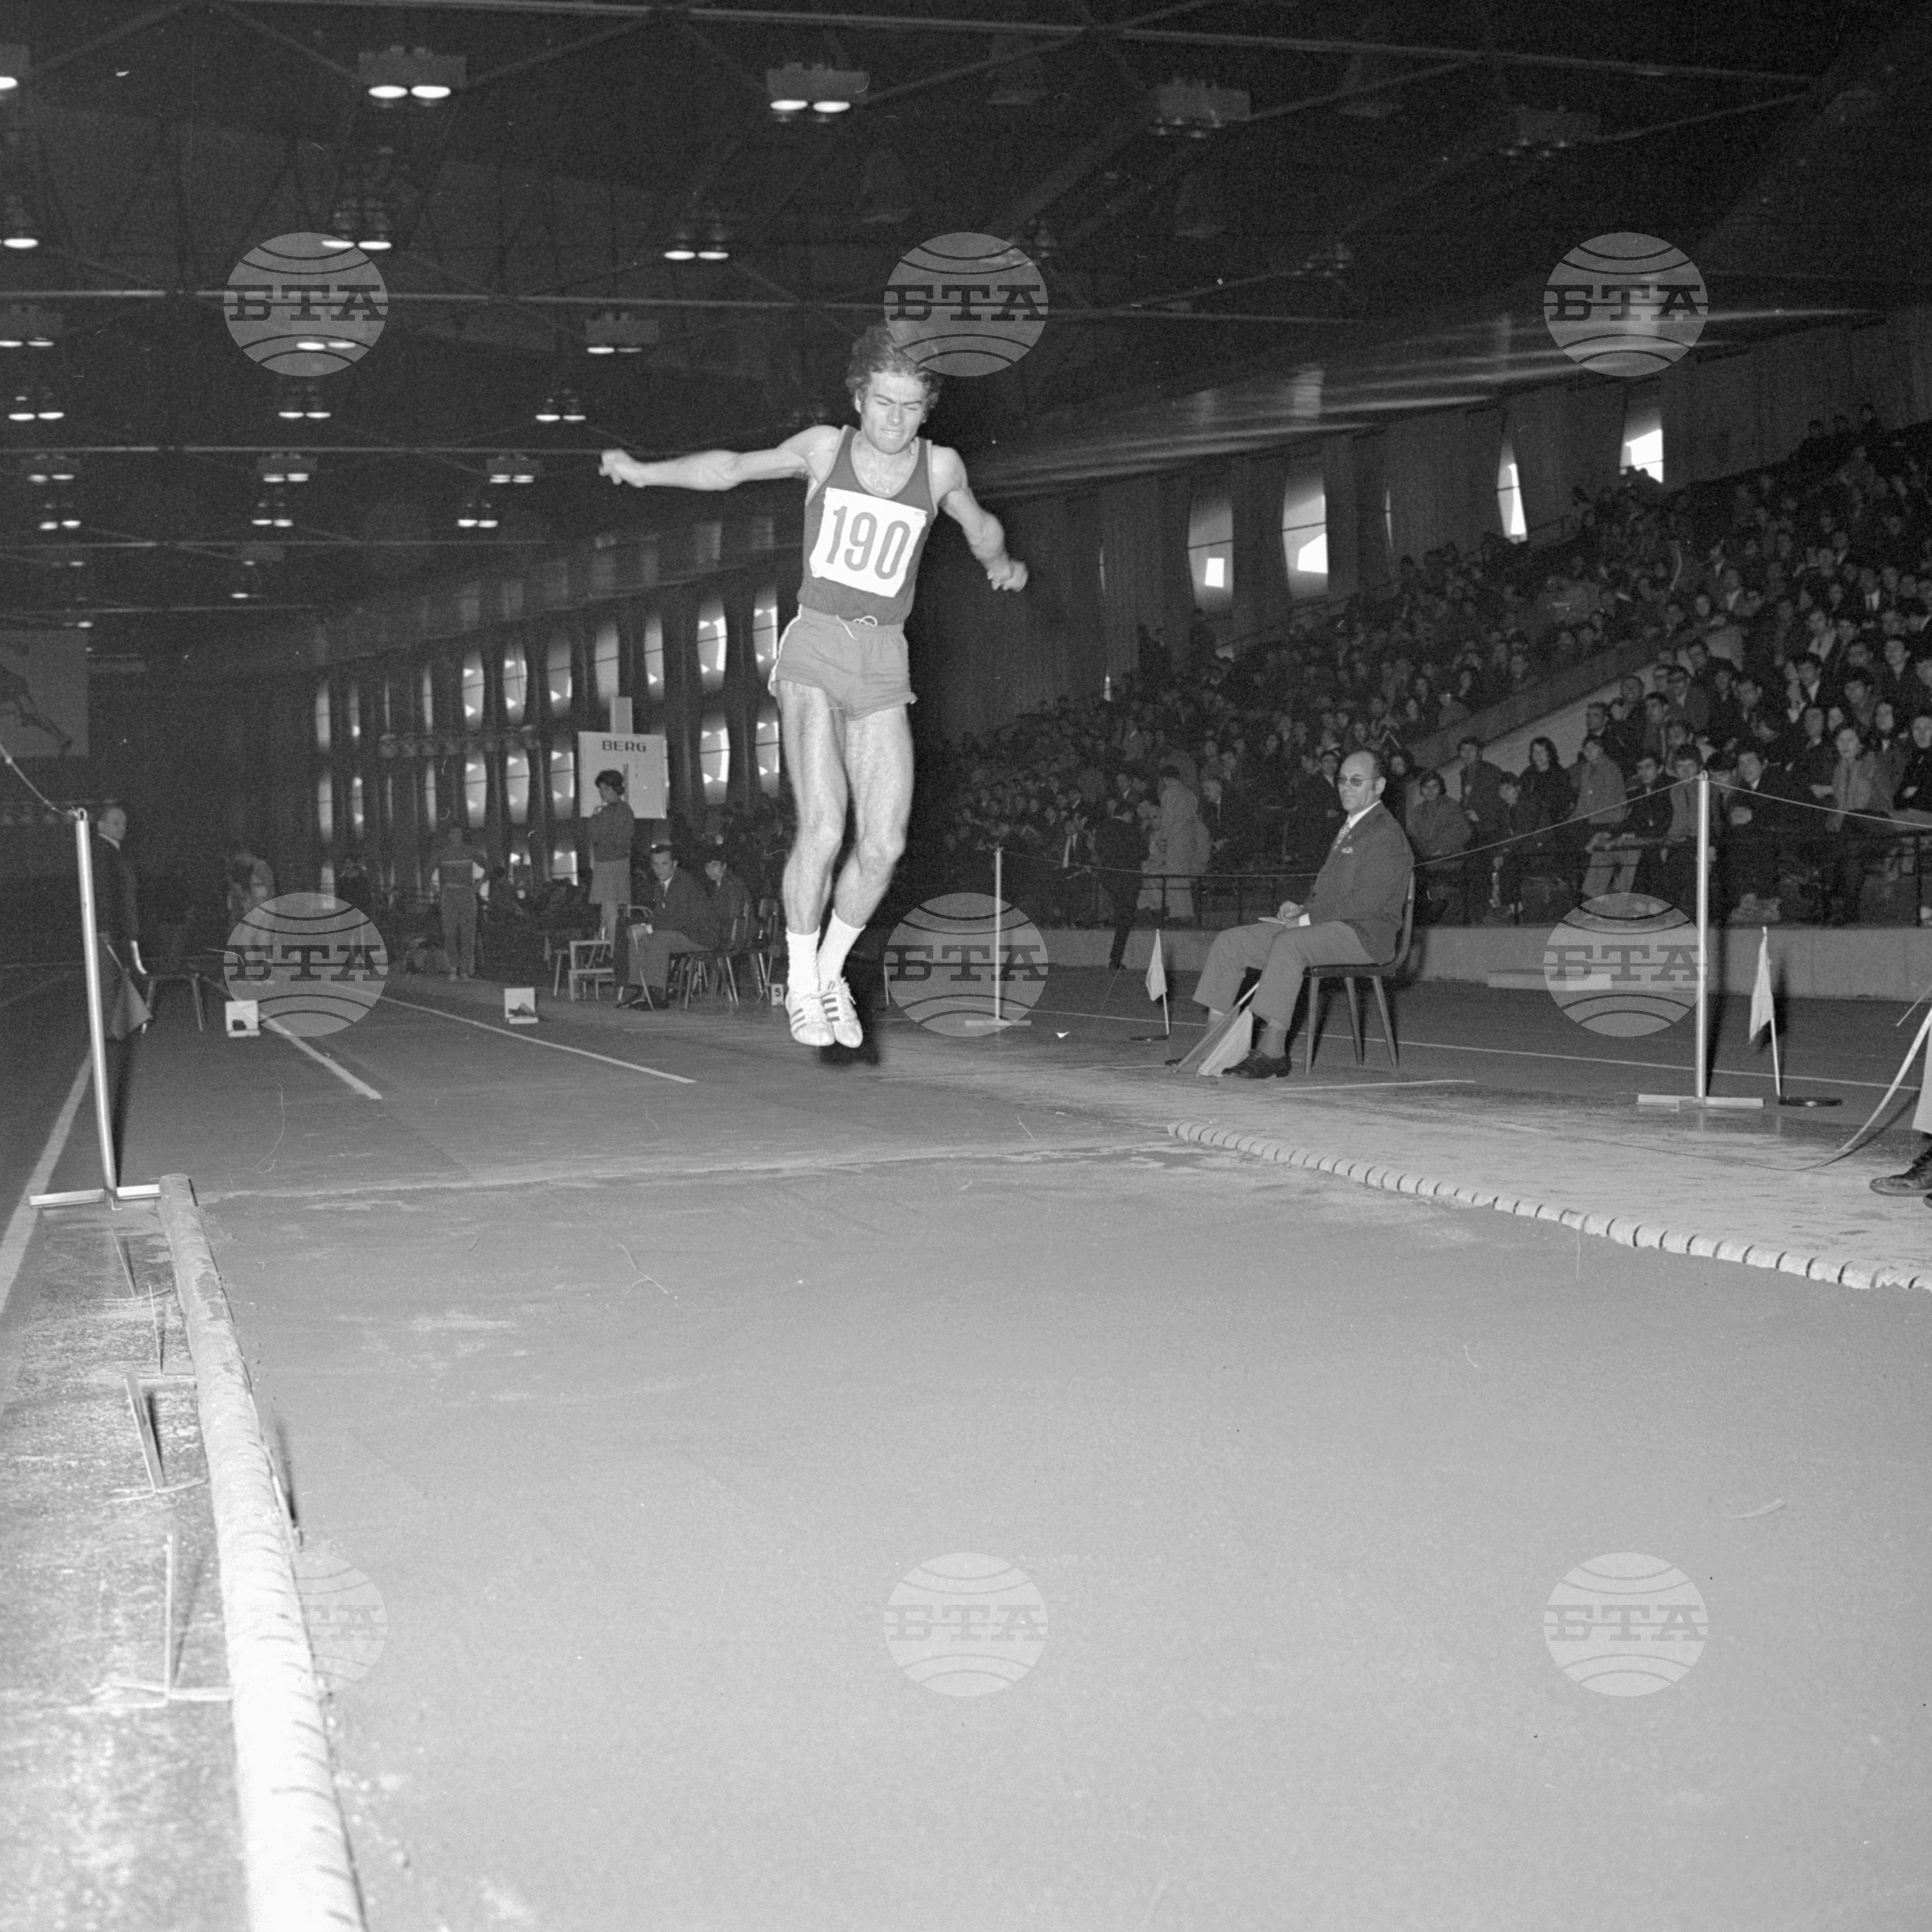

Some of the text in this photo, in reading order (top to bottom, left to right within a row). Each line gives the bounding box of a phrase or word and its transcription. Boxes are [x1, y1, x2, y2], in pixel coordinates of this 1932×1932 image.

[825, 505, 911, 580] 190
[602, 740, 647, 752] BERG
[775, 988, 781, 997] 5
